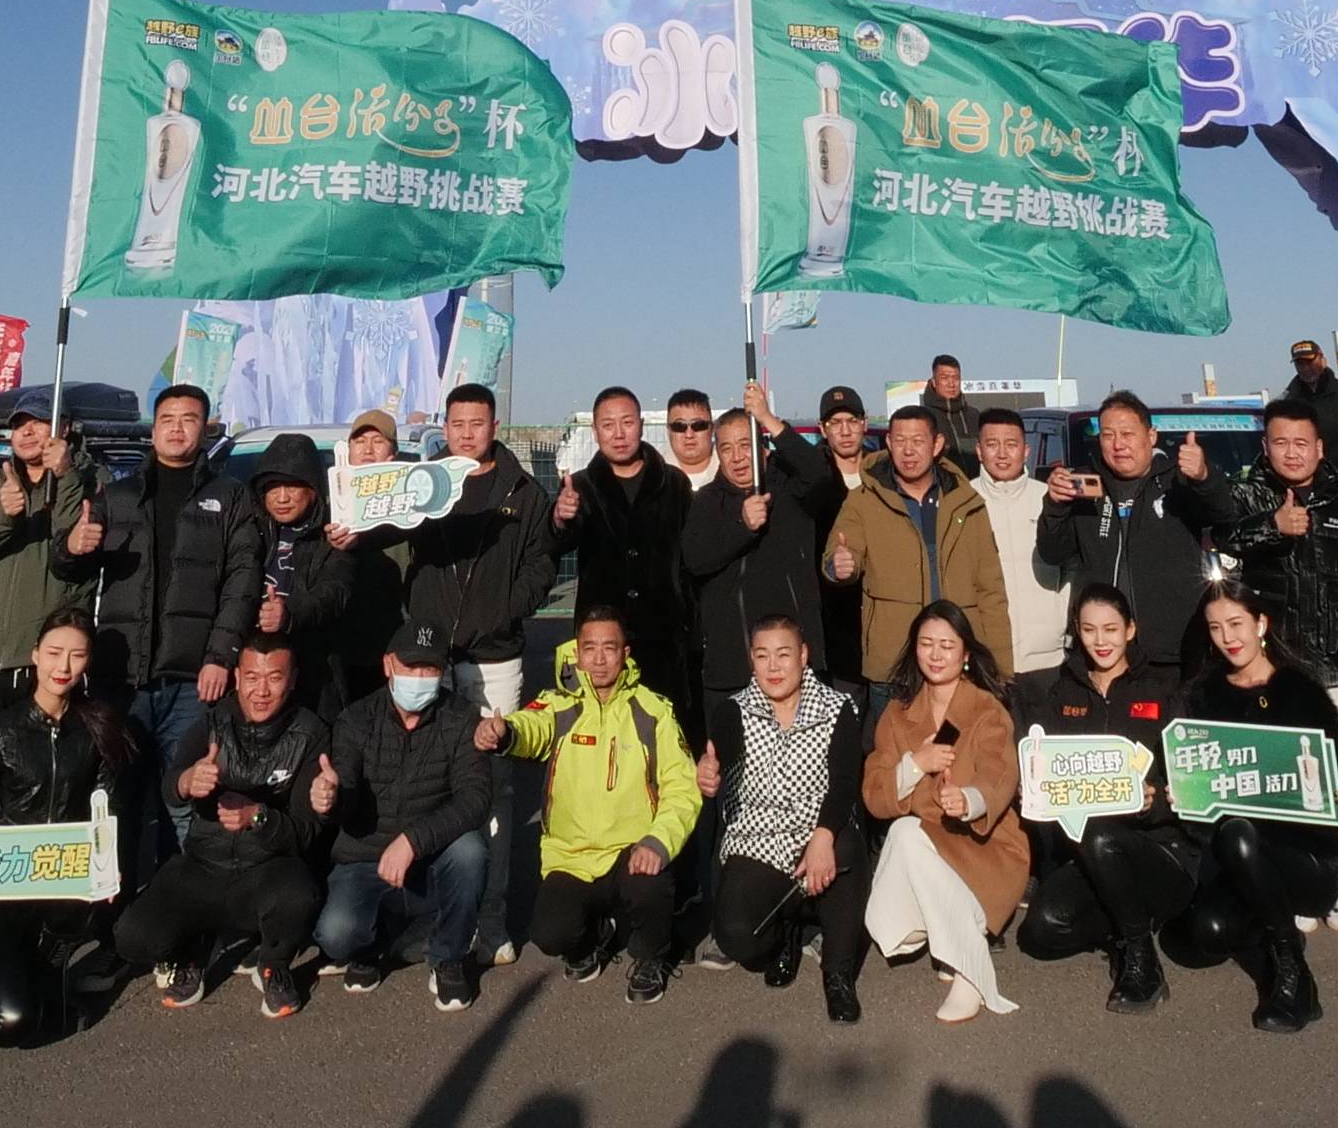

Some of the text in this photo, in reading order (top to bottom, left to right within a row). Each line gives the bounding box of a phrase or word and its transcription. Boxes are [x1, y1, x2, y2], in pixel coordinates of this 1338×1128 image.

[210, 159, 528, 217] 河北汽车越野挑战赛
[870, 168, 1172, 241] 河北汽车越野挑战赛
[362, 491, 419, 521] 越野
[1052, 750, 1123, 776] 心向越野
[1040, 776, 1133, 805] “活”力全开
[1211, 769, 1299, 800] 中国活力
